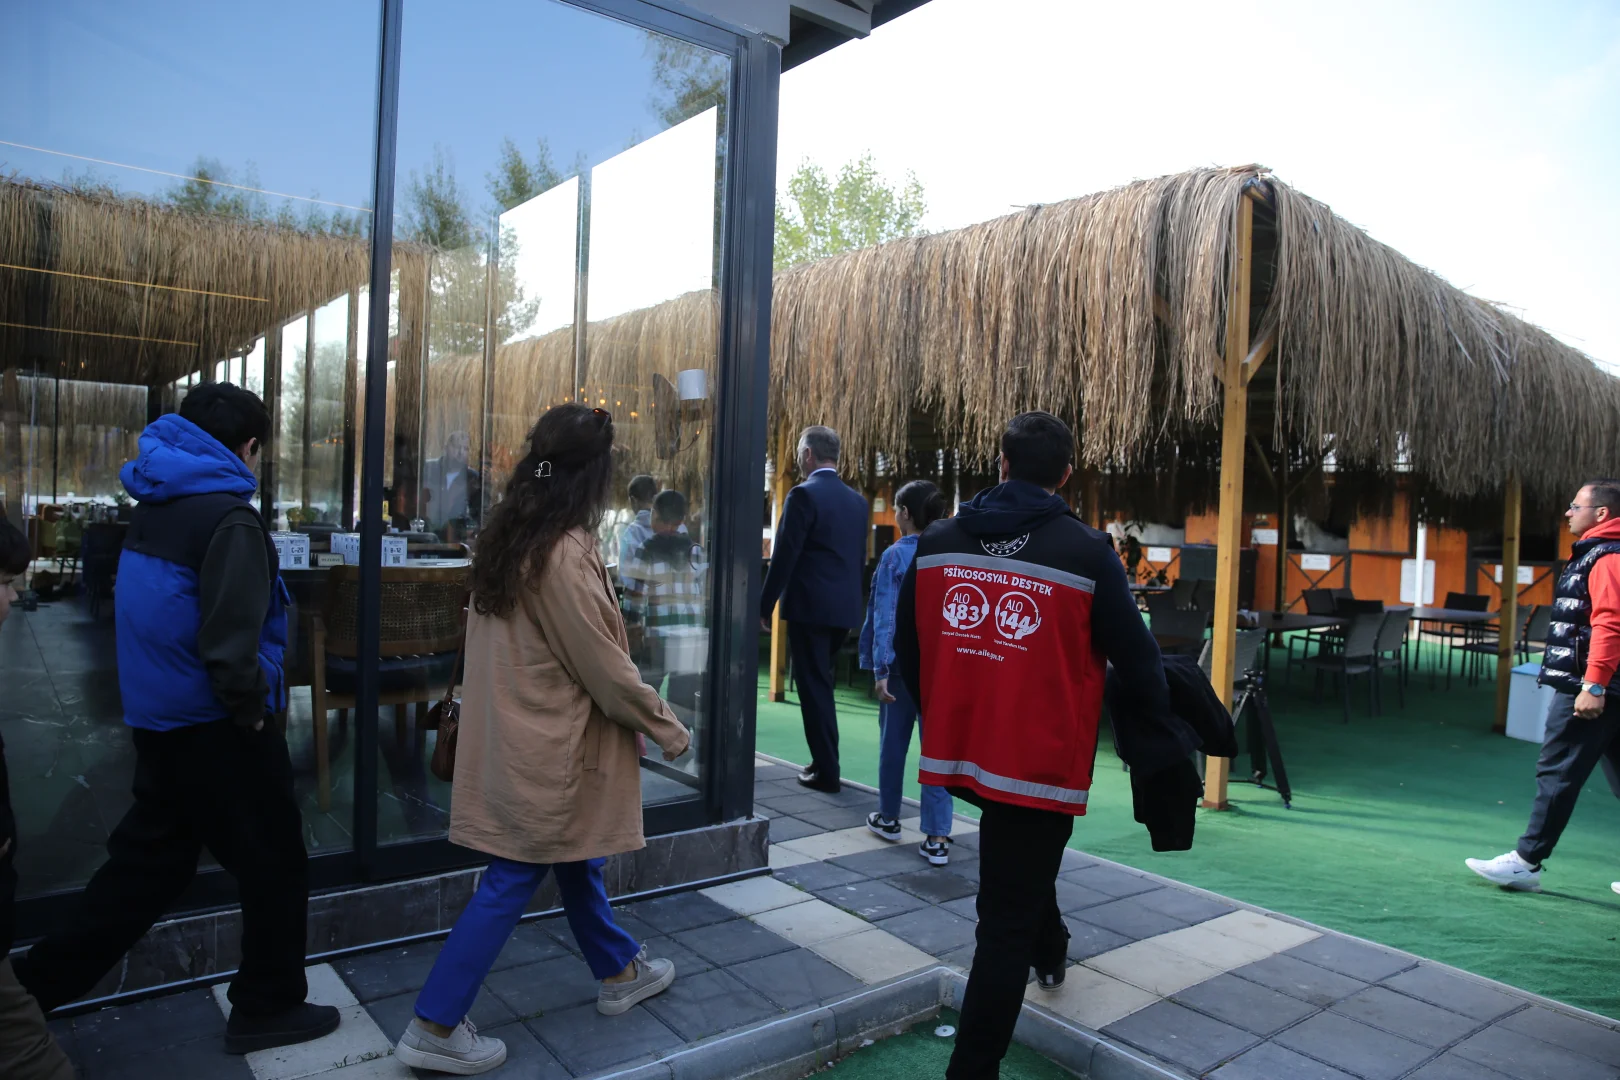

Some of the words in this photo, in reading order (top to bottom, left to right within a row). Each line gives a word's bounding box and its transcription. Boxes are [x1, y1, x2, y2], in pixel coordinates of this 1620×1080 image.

[944, 566, 1008, 585] PSİKOSOSYAL
[1011, 576, 1053, 596] DESTEK
[952, 592, 970, 604] ALO
[1005, 599, 1024, 612] ALO
[947, 603, 979, 621] 183
[1000, 610, 1031, 633] 144
